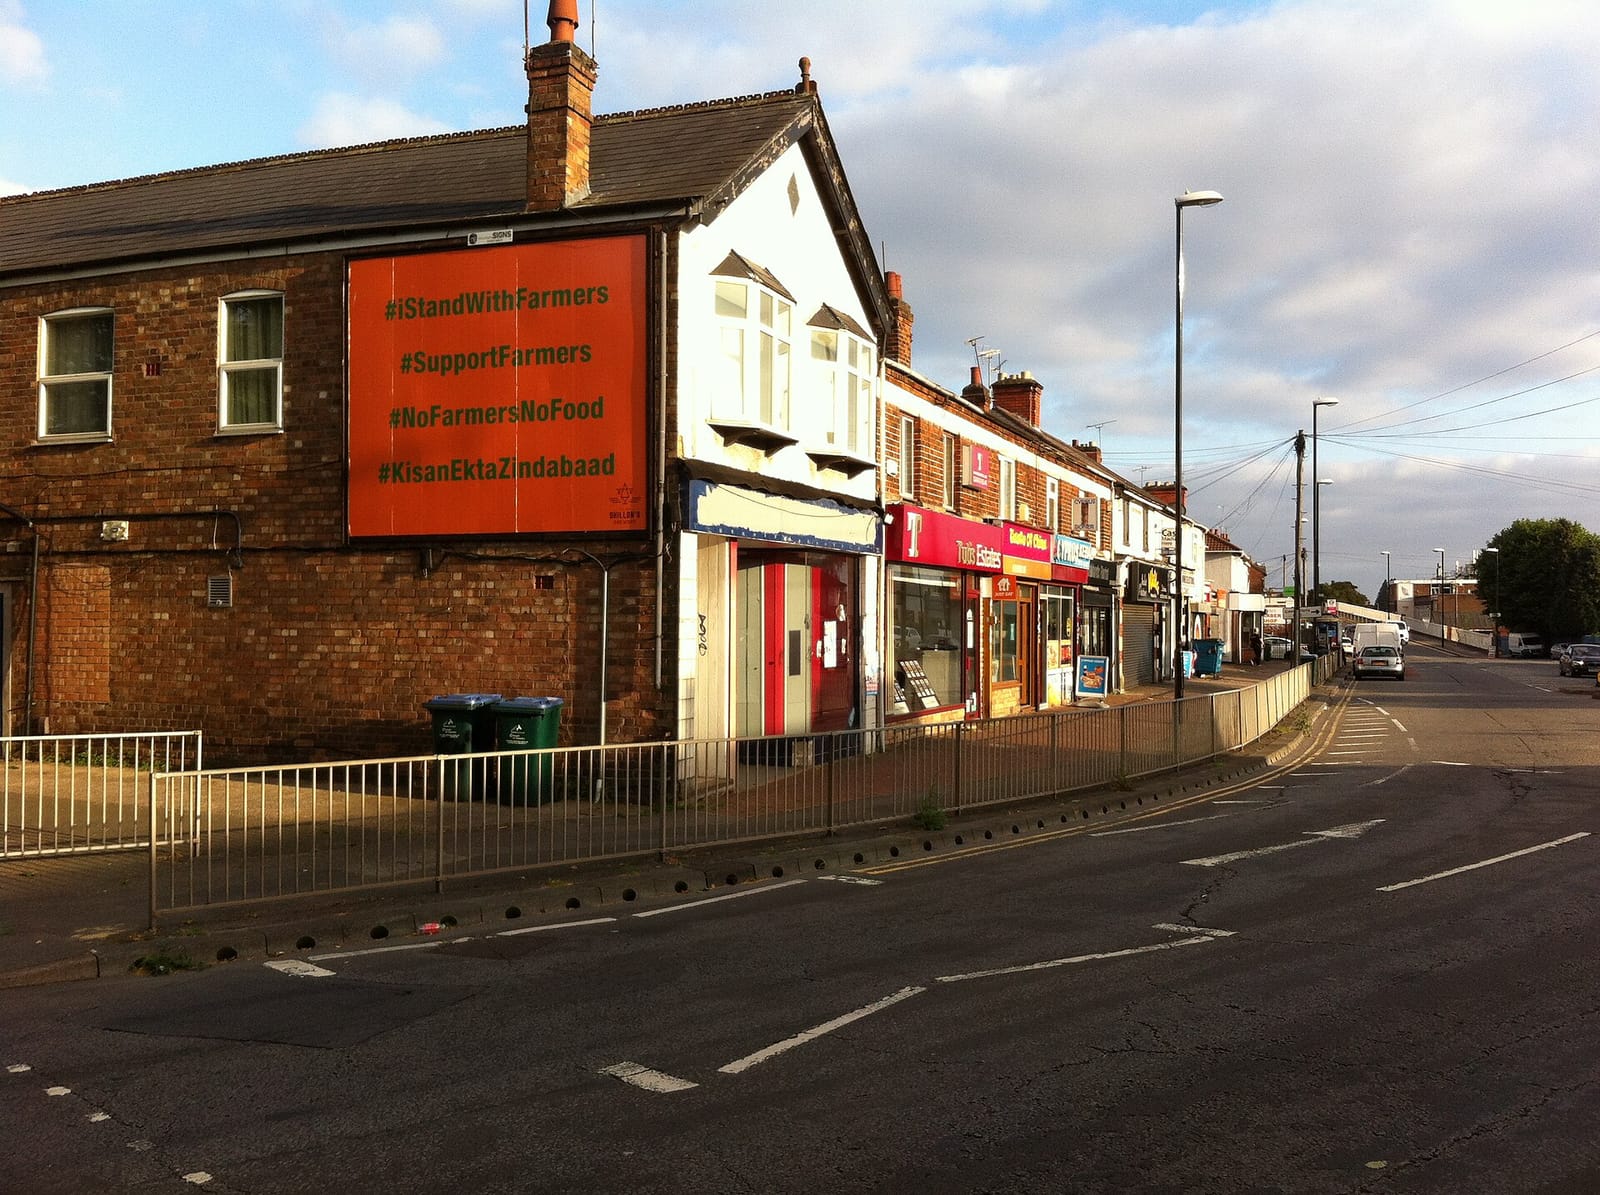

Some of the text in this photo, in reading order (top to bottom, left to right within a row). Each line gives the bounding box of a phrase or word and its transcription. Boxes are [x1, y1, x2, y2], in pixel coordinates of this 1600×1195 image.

[385, 285, 609, 321] #iStandWithFarmers
[400, 344, 592, 376] #SupportFarmers
[389, 396, 604, 429] #NoFarmersNoFood
[378, 453, 615, 484] #KisanEktaZindabaad
[976, 544, 1002, 569] Estates
